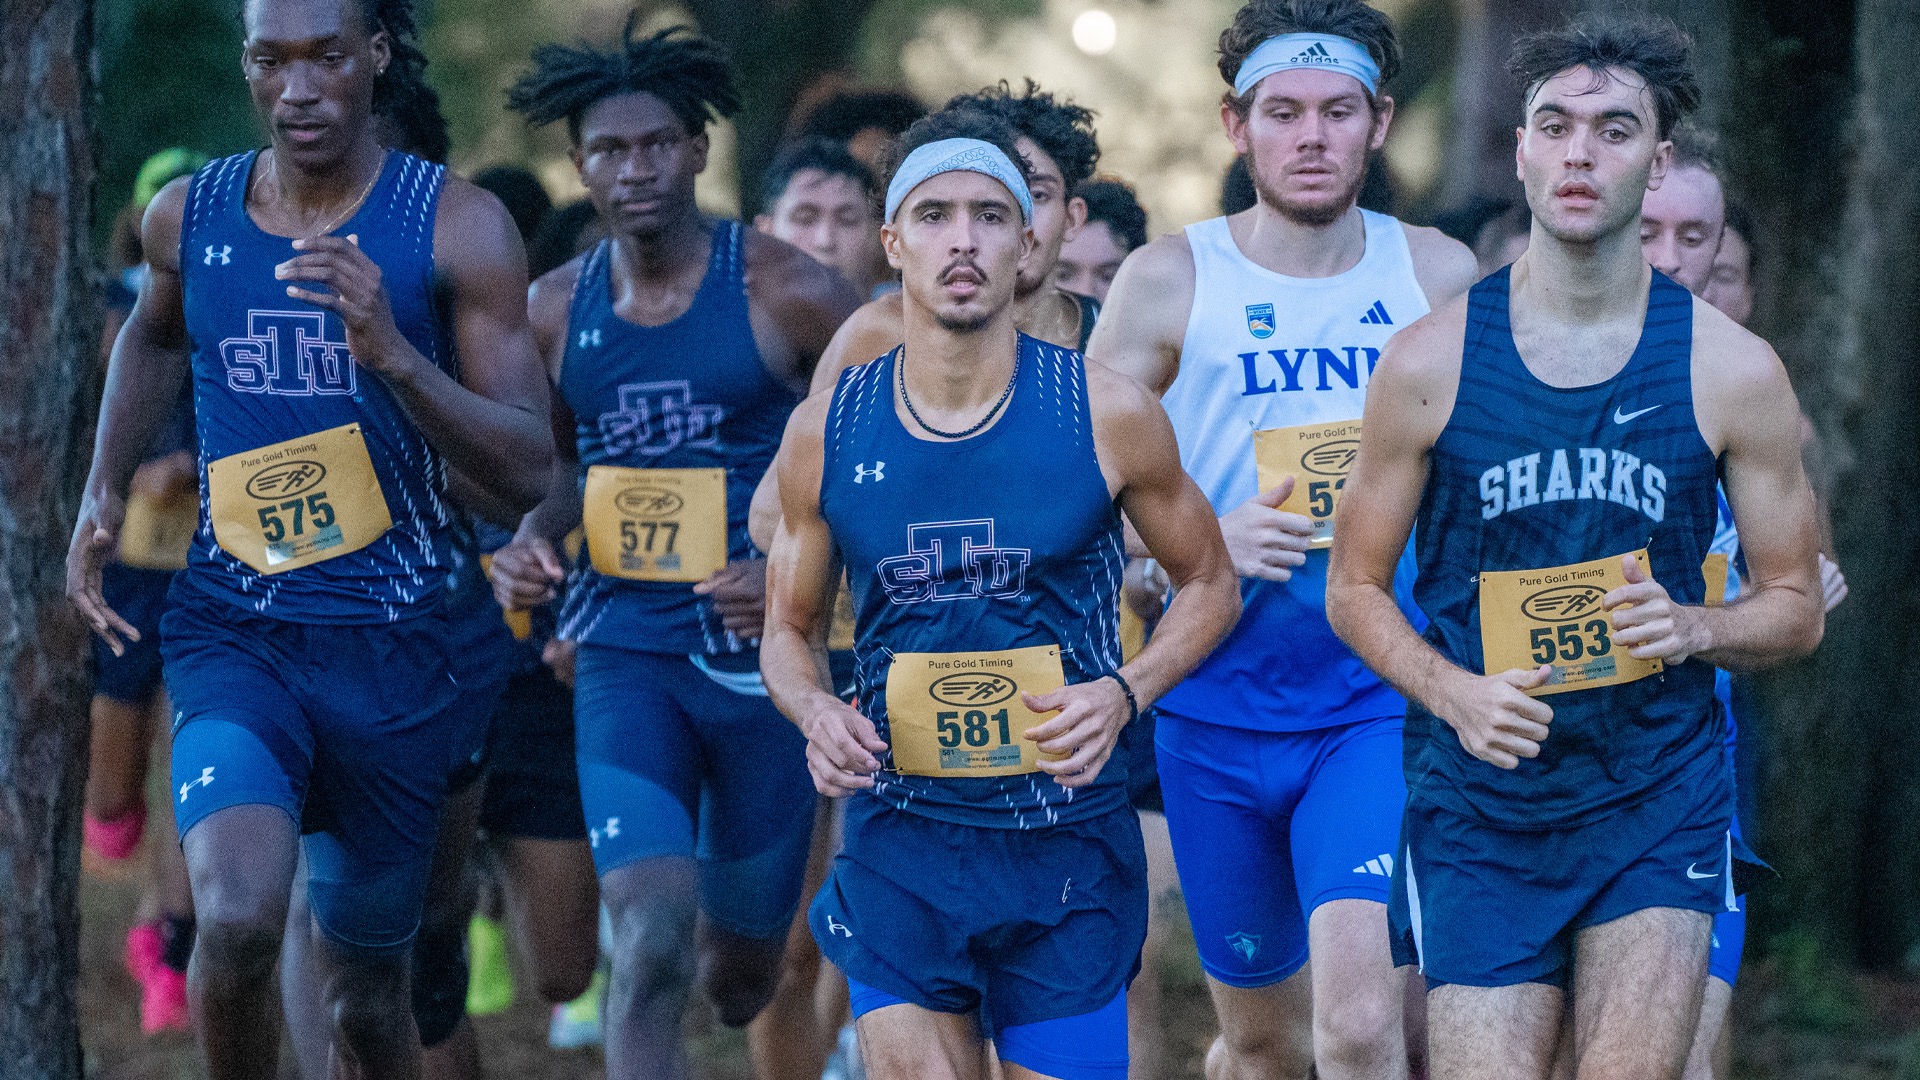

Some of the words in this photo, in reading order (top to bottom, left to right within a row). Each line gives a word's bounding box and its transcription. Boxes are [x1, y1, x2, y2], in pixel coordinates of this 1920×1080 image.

[1290, 55, 1339, 64] adidas
[219, 309, 357, 396] STU
[1299, 432, 1321, 440] Pure
[1324, 428, 1346, 438] Gold
[1348, 425, 1362, 435] Tim
[240, 458, 261, 468] Pure
[262, 451, 283, 463] Gold
[284, 443, 317, 457] Timing
[1479, 447, 1667, 523] SHARKS
[257, 491, 335, 542] 575
[621, 521, 680, 553] 577
[877, 518, 1031, 605] STU
[1519, 578, 1542, 587] Pure
[1544, 573, 1569, 584] Gold
[1570, 568, 1605, 580] Timing
[1020, 595, 1031, 603] TM
[1530, 619, 1612, 665] 553
[928, 660, 951, 669] Pure
[953, 659, 977, 668] Gold
[979, 658, 1013, 668] Timing
[936, 708, 1012, 748] 581
